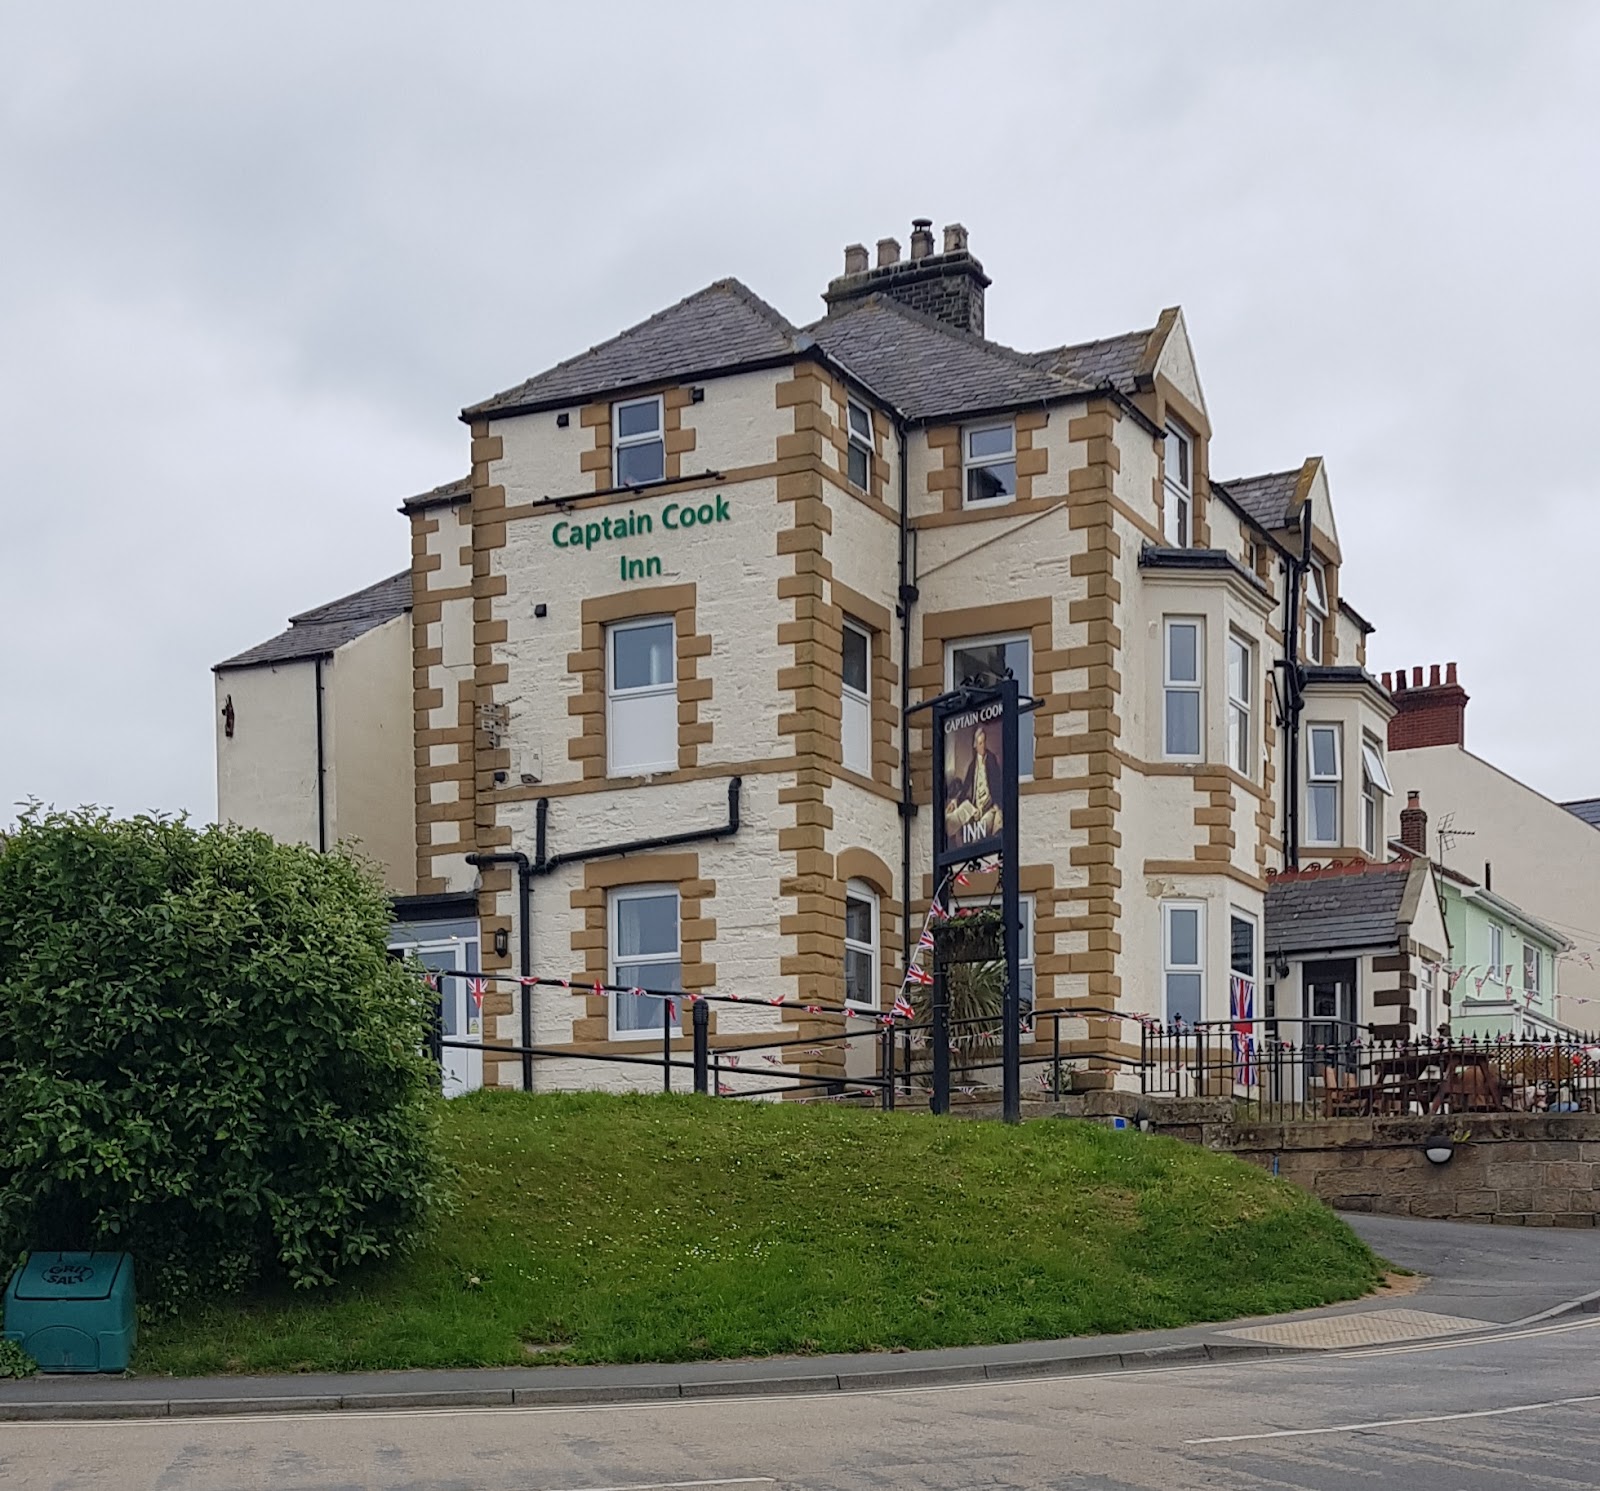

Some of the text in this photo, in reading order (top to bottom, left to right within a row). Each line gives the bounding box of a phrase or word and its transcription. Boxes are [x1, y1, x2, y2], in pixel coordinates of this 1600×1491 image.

[552, 494, 731, 551] Captain Cook
[620, 555, 662, 581] Inn
[944, 711, 979, 734] CAPTAIN
[962, 820, 987, 844] INN
[46, 1275, 84, 1285] SALT
[49, 1265, 92, 1275] GRIT
